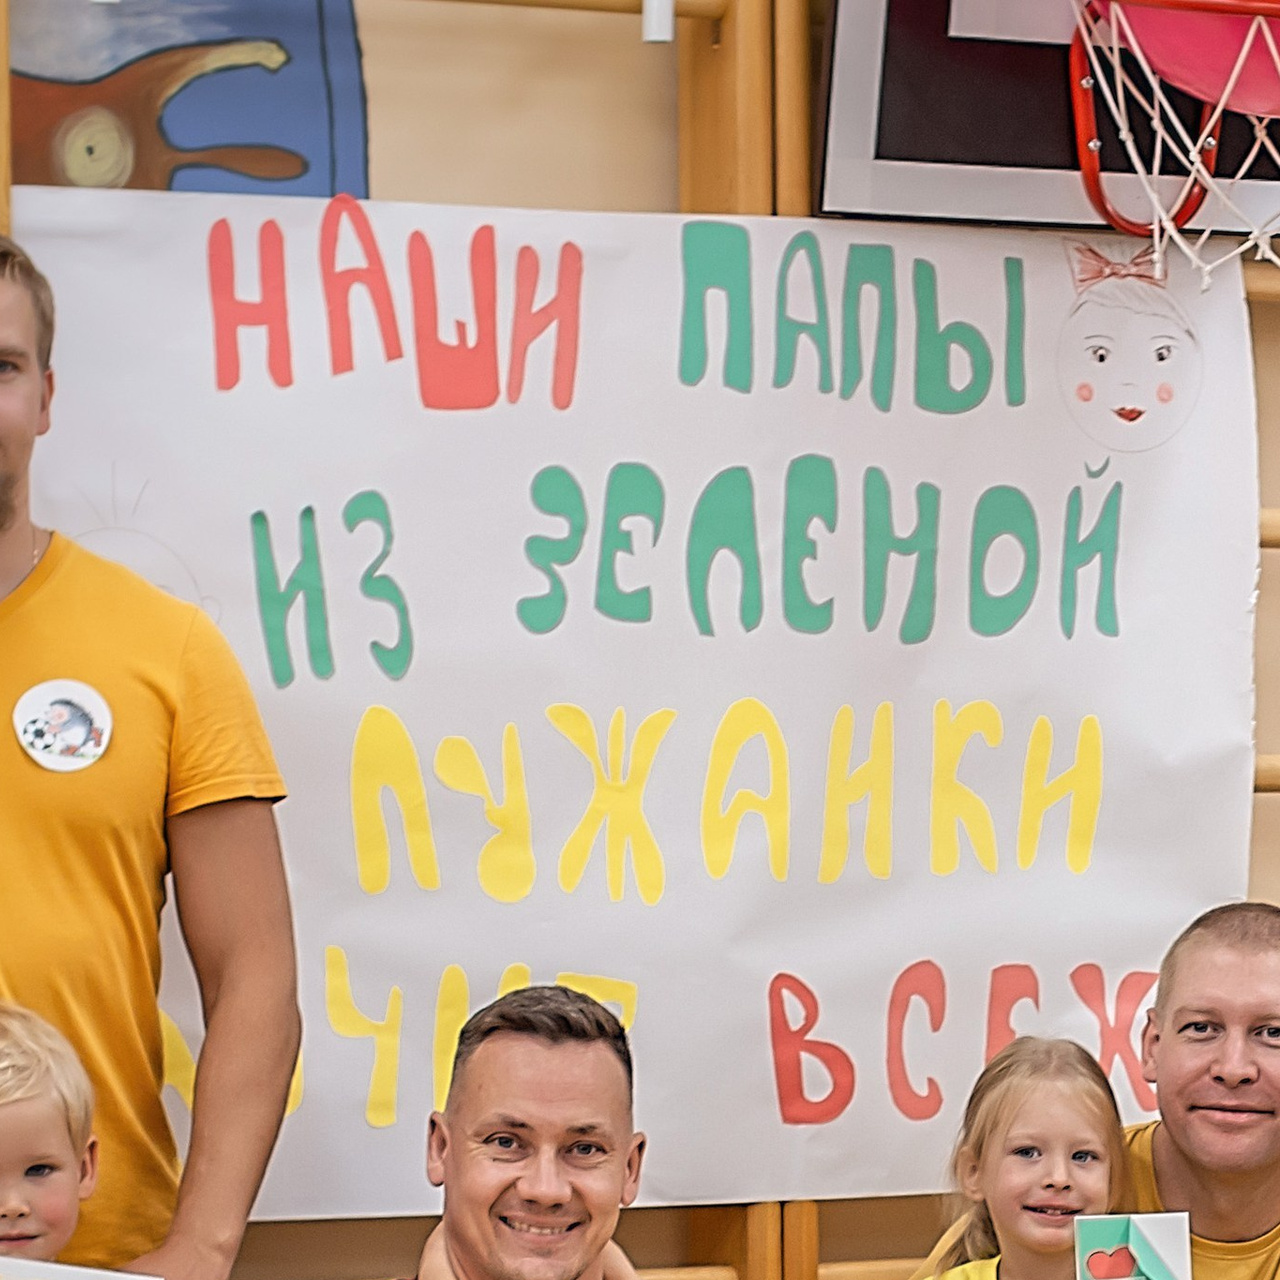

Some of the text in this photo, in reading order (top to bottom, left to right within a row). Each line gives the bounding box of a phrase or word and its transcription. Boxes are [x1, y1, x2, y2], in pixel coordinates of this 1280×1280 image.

[208, 193, 1026, 415] НАШИ ПАПЫ
[251, 453, 1123, 689] ИЗ ЗЕЛЕНОЙ
